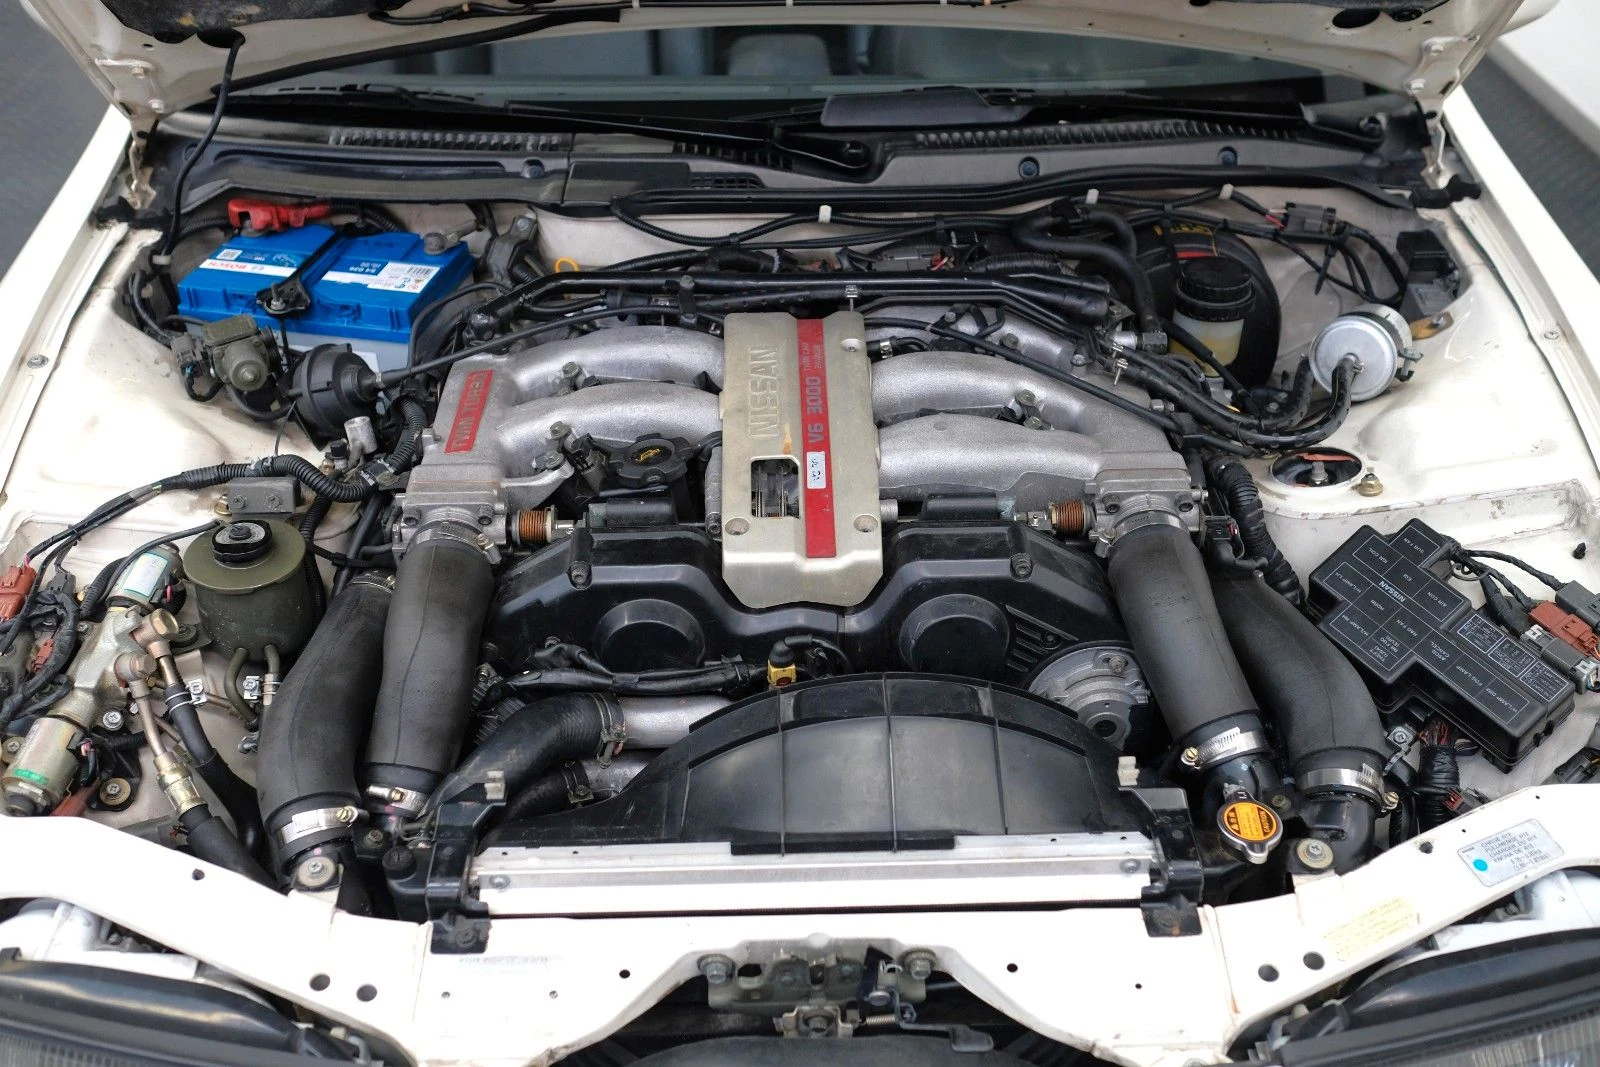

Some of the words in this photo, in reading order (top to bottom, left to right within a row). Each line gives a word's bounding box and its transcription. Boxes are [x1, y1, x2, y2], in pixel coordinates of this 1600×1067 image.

[462, 372, 491, 411] TURBO
[748, 348, 779, 438] NISSAN
[804, 376, 824, 415] 3000
[451, 416, 475, 449] TWIN
[808, 422, 825, 444] V6
[1377, 579, 1406, 602] NISSAN
[1395, 618, 1408, 629] FAN
[1429, 640, 1450, 658] CANCEL
[1455, 663, 1471, 677] LAMP
